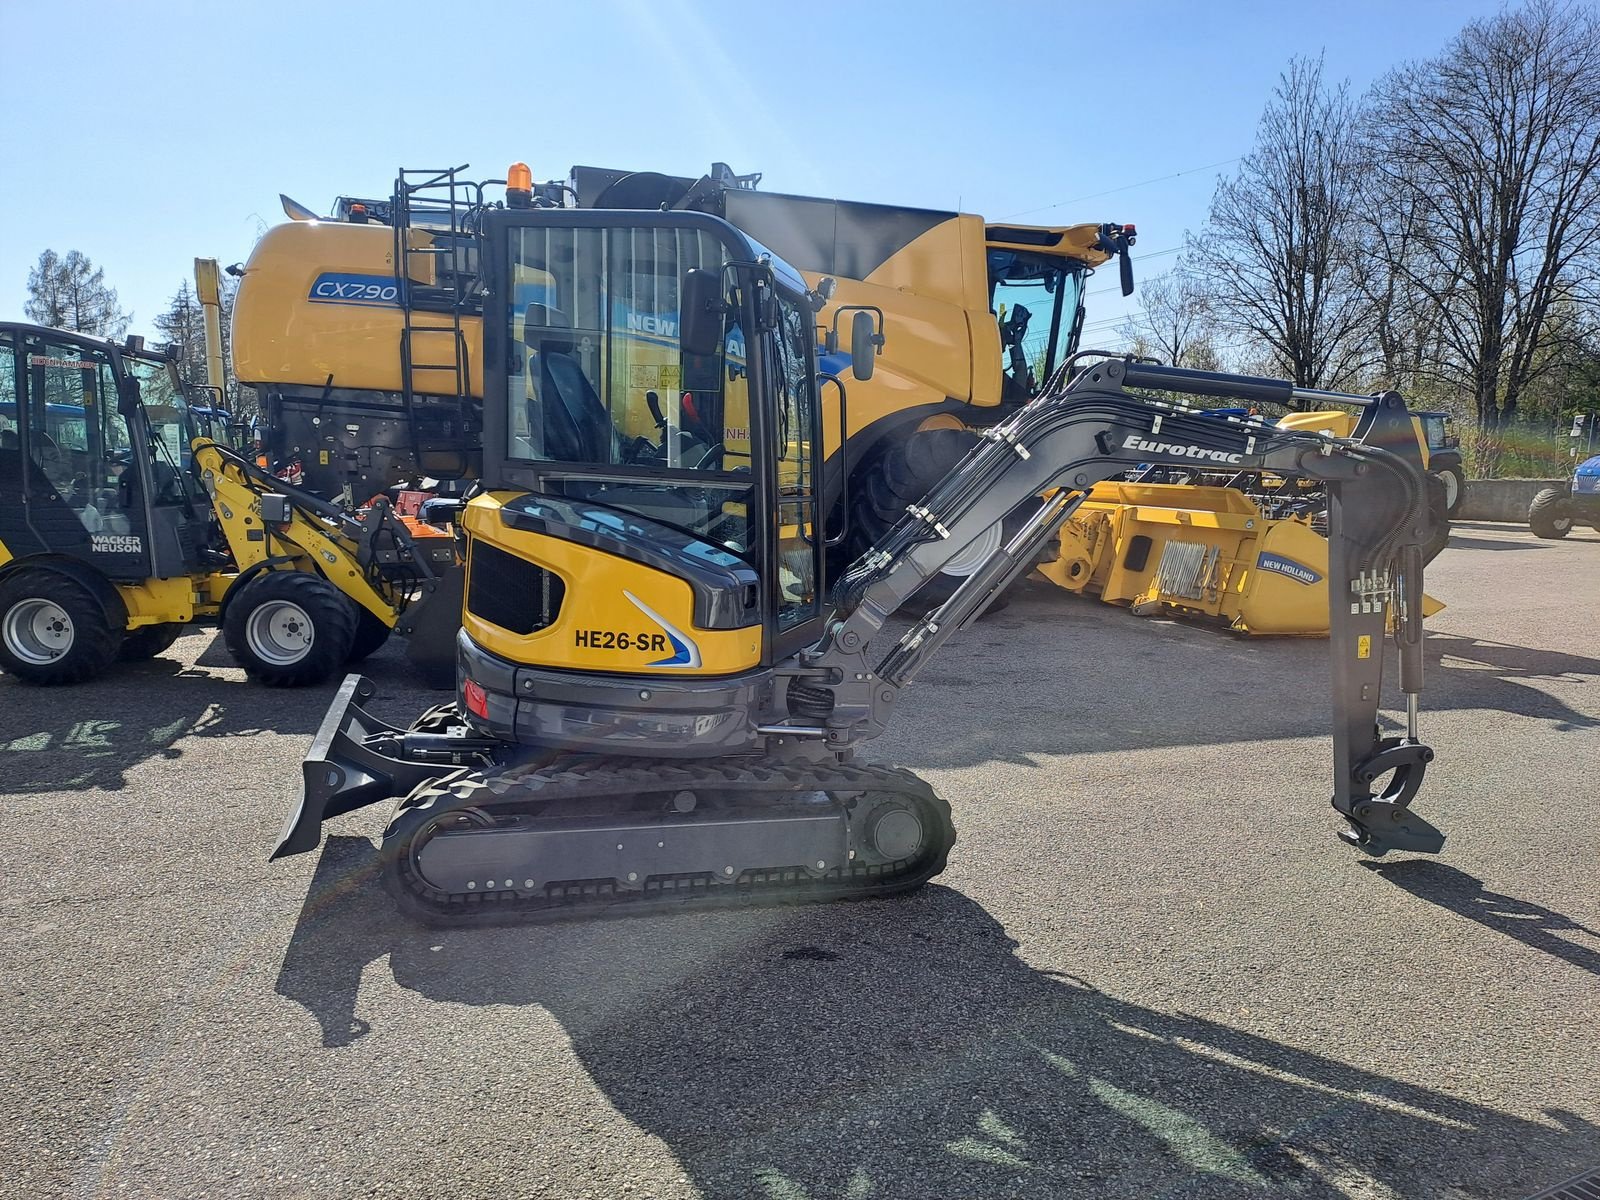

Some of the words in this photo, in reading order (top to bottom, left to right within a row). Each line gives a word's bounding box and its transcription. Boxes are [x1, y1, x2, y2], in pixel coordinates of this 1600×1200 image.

[316, 281, 398, 300] CX7.90
[627, 312, 676, 337] NEW
[1121, 435, 1243, 464] Eurotrac
[91, 535, 141, 545] WACKER
[92, 543, 142, 553] NEUSON
[1263, 559, 1282, 570] NEW
[1281, 563, 1314, 582] HOLLAND
[575, 630, 666, 652] HE26-SR
